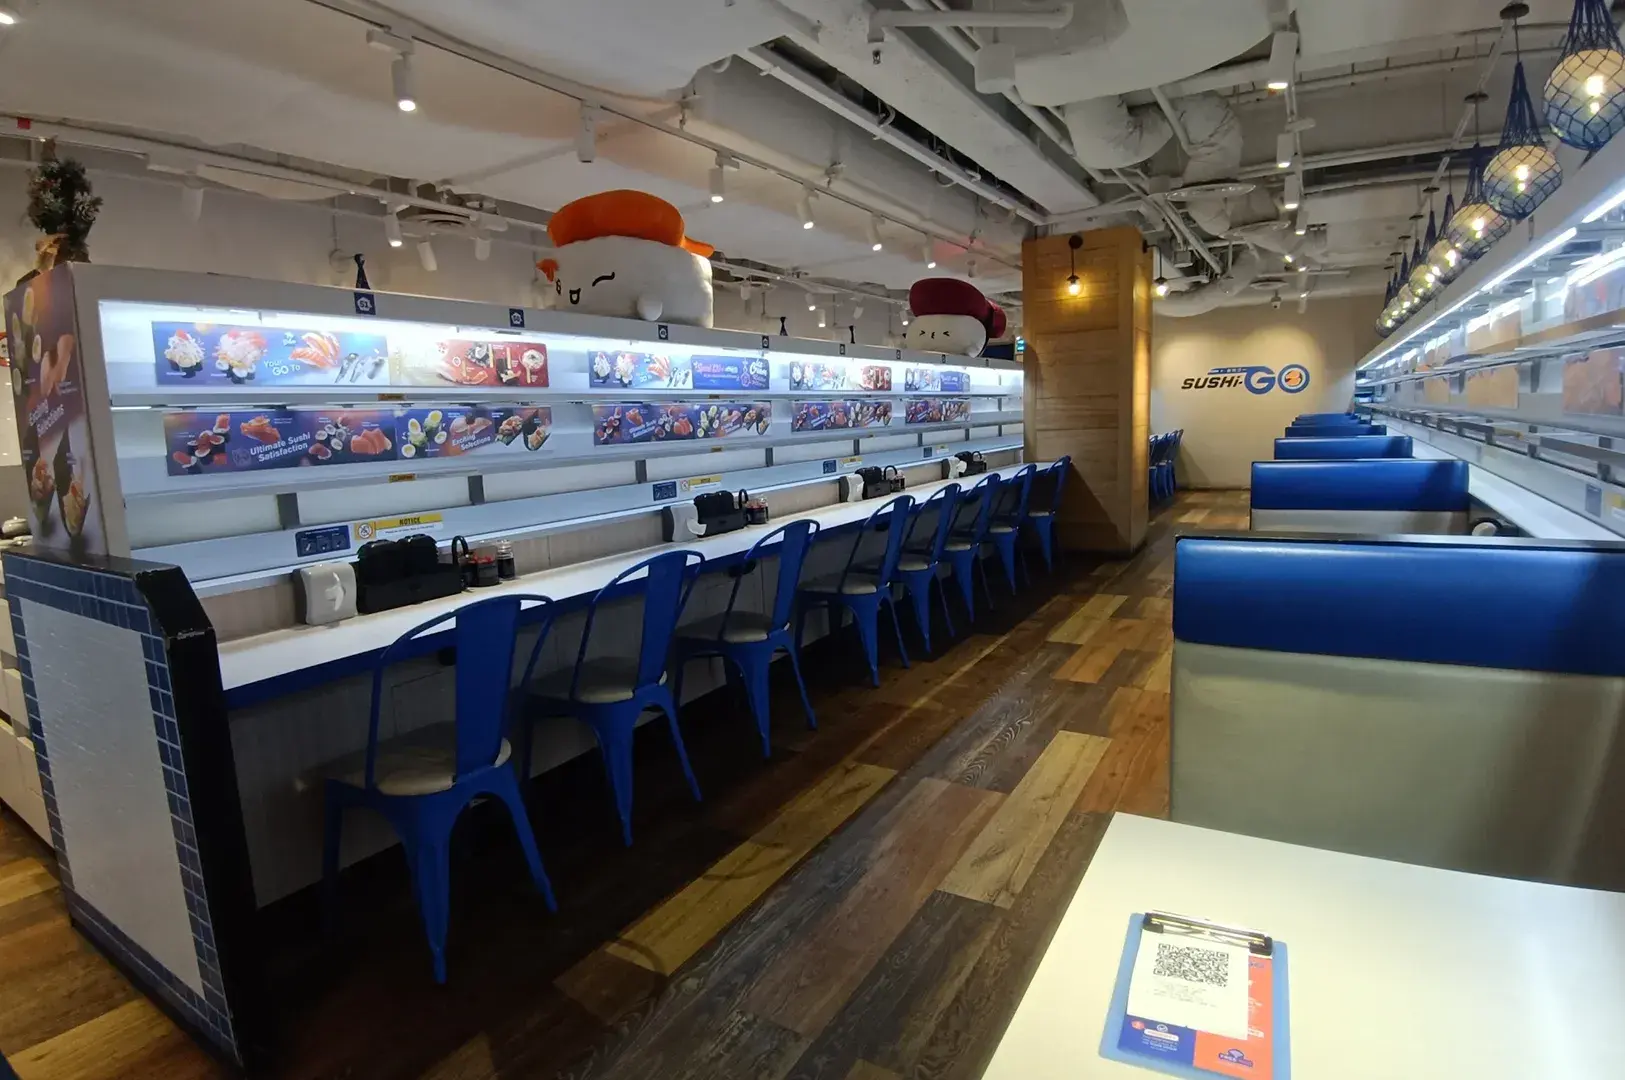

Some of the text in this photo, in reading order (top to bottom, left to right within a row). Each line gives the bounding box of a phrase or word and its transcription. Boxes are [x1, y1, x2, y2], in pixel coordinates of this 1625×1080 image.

[250, 432, 311, 456] Ultimate Sushi
[258, 442, 308, 462] Satisfaction
[399, 516, 421, 526] NOTICE
